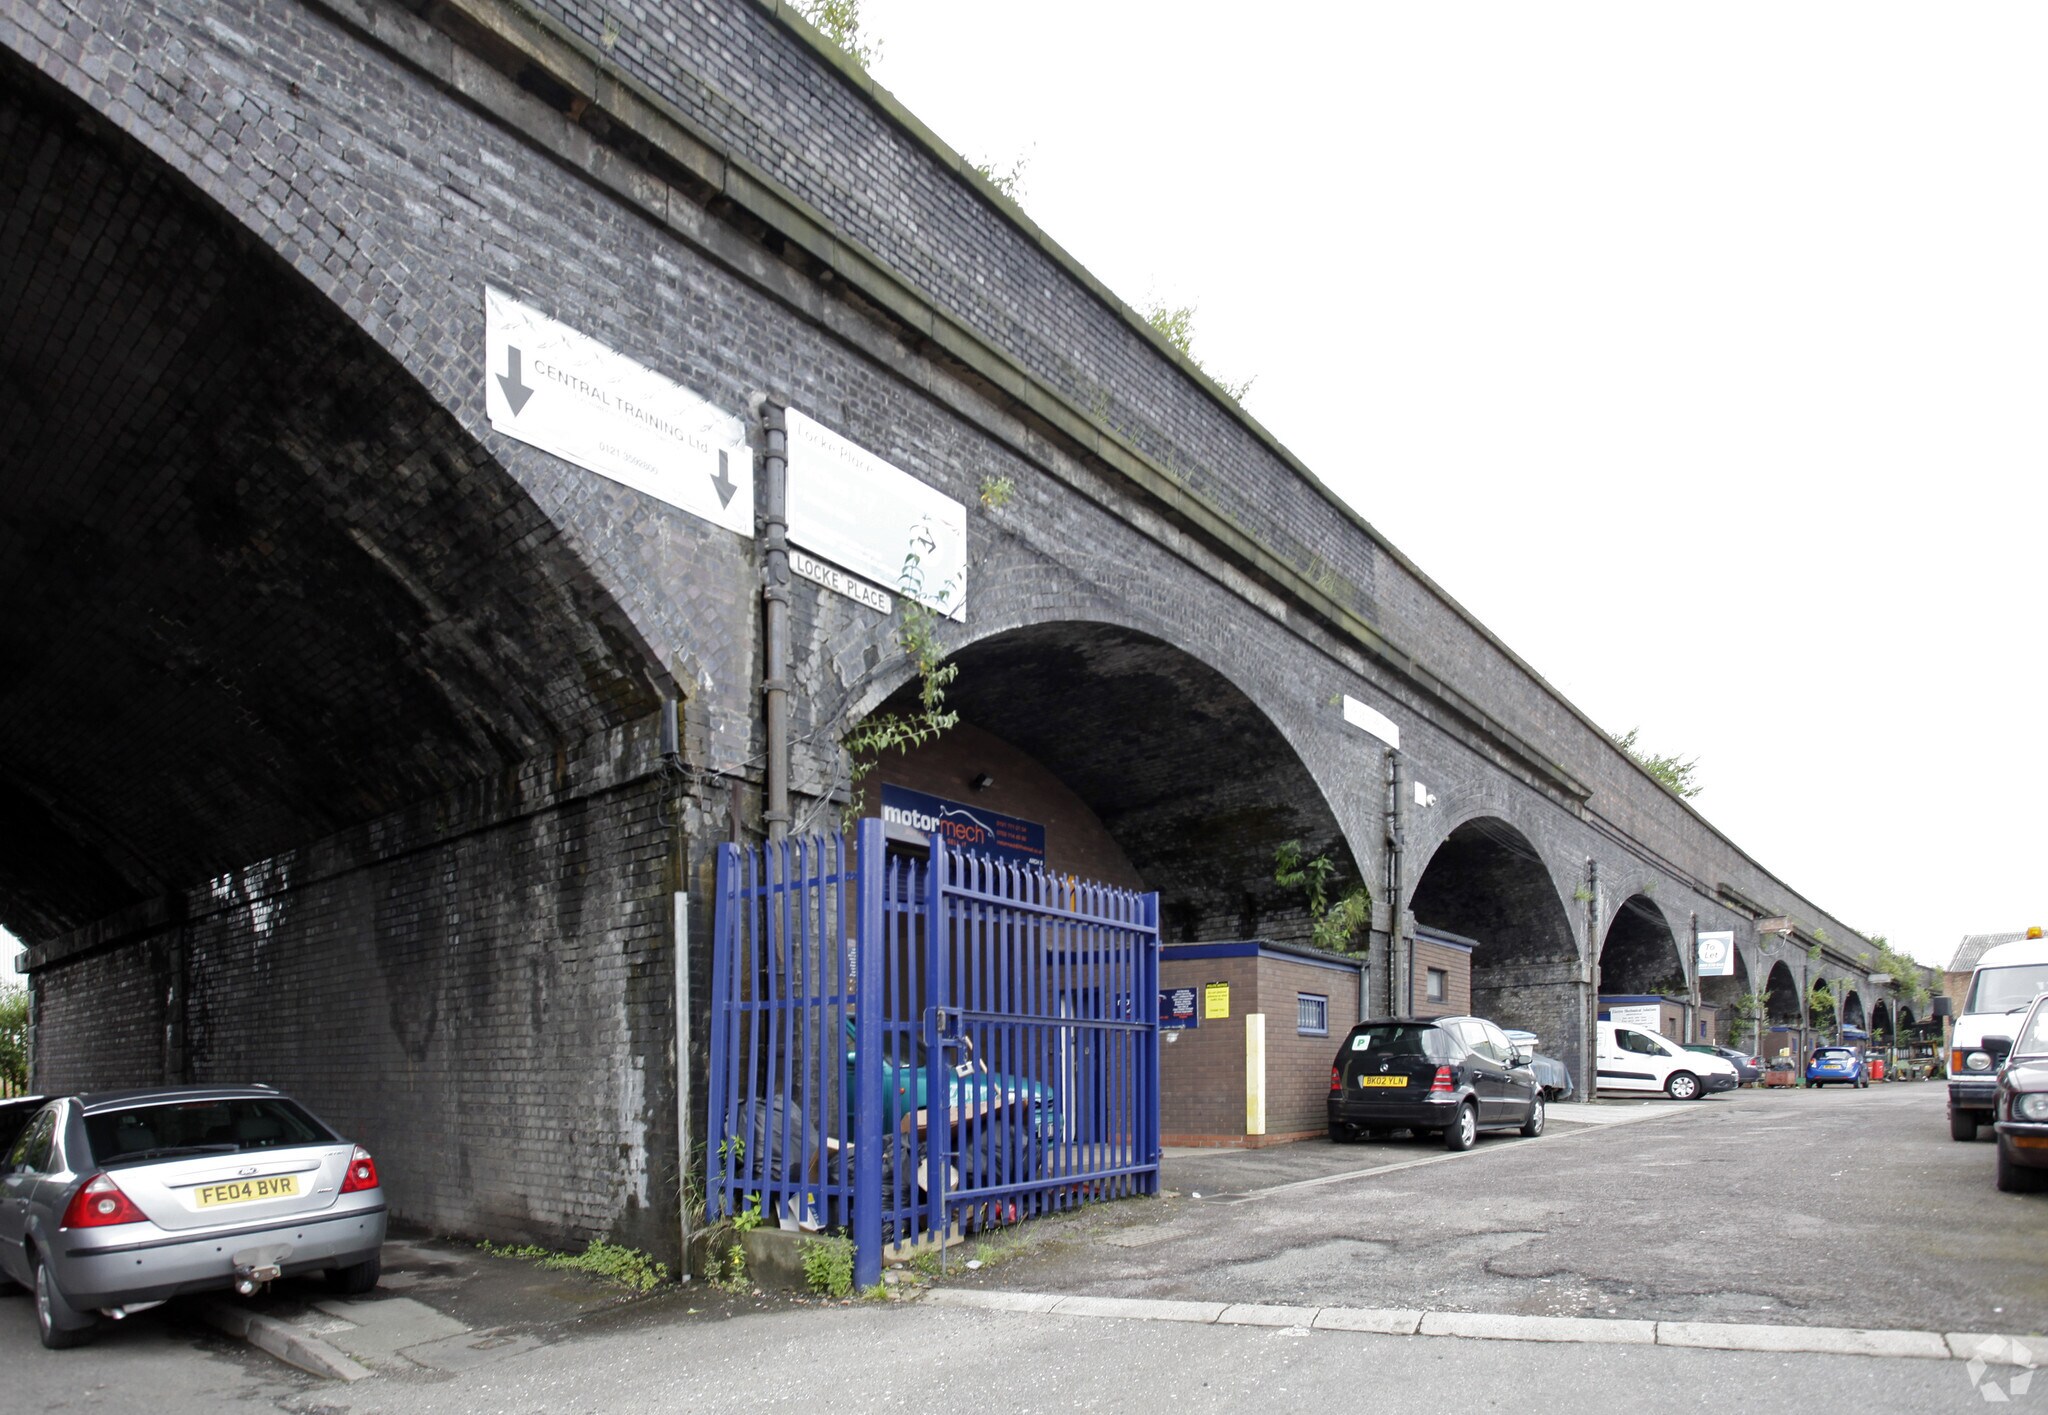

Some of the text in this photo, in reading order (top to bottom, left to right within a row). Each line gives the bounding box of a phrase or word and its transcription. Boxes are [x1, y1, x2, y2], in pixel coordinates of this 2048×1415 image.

[534, 359, 708, 454] CENTRAL TRAINING Ltd
[599, 441, 620, 457] 0121
[797, 557, 886, 609] LOCKE PLACE
[1705, 943, 1715, 951] To
[1357, 1039, 1365, 1047] P
[1366, 1076, 1404, 1085] BK02 YLN
[202, 1178, 291, 1204] FE04 BVR
